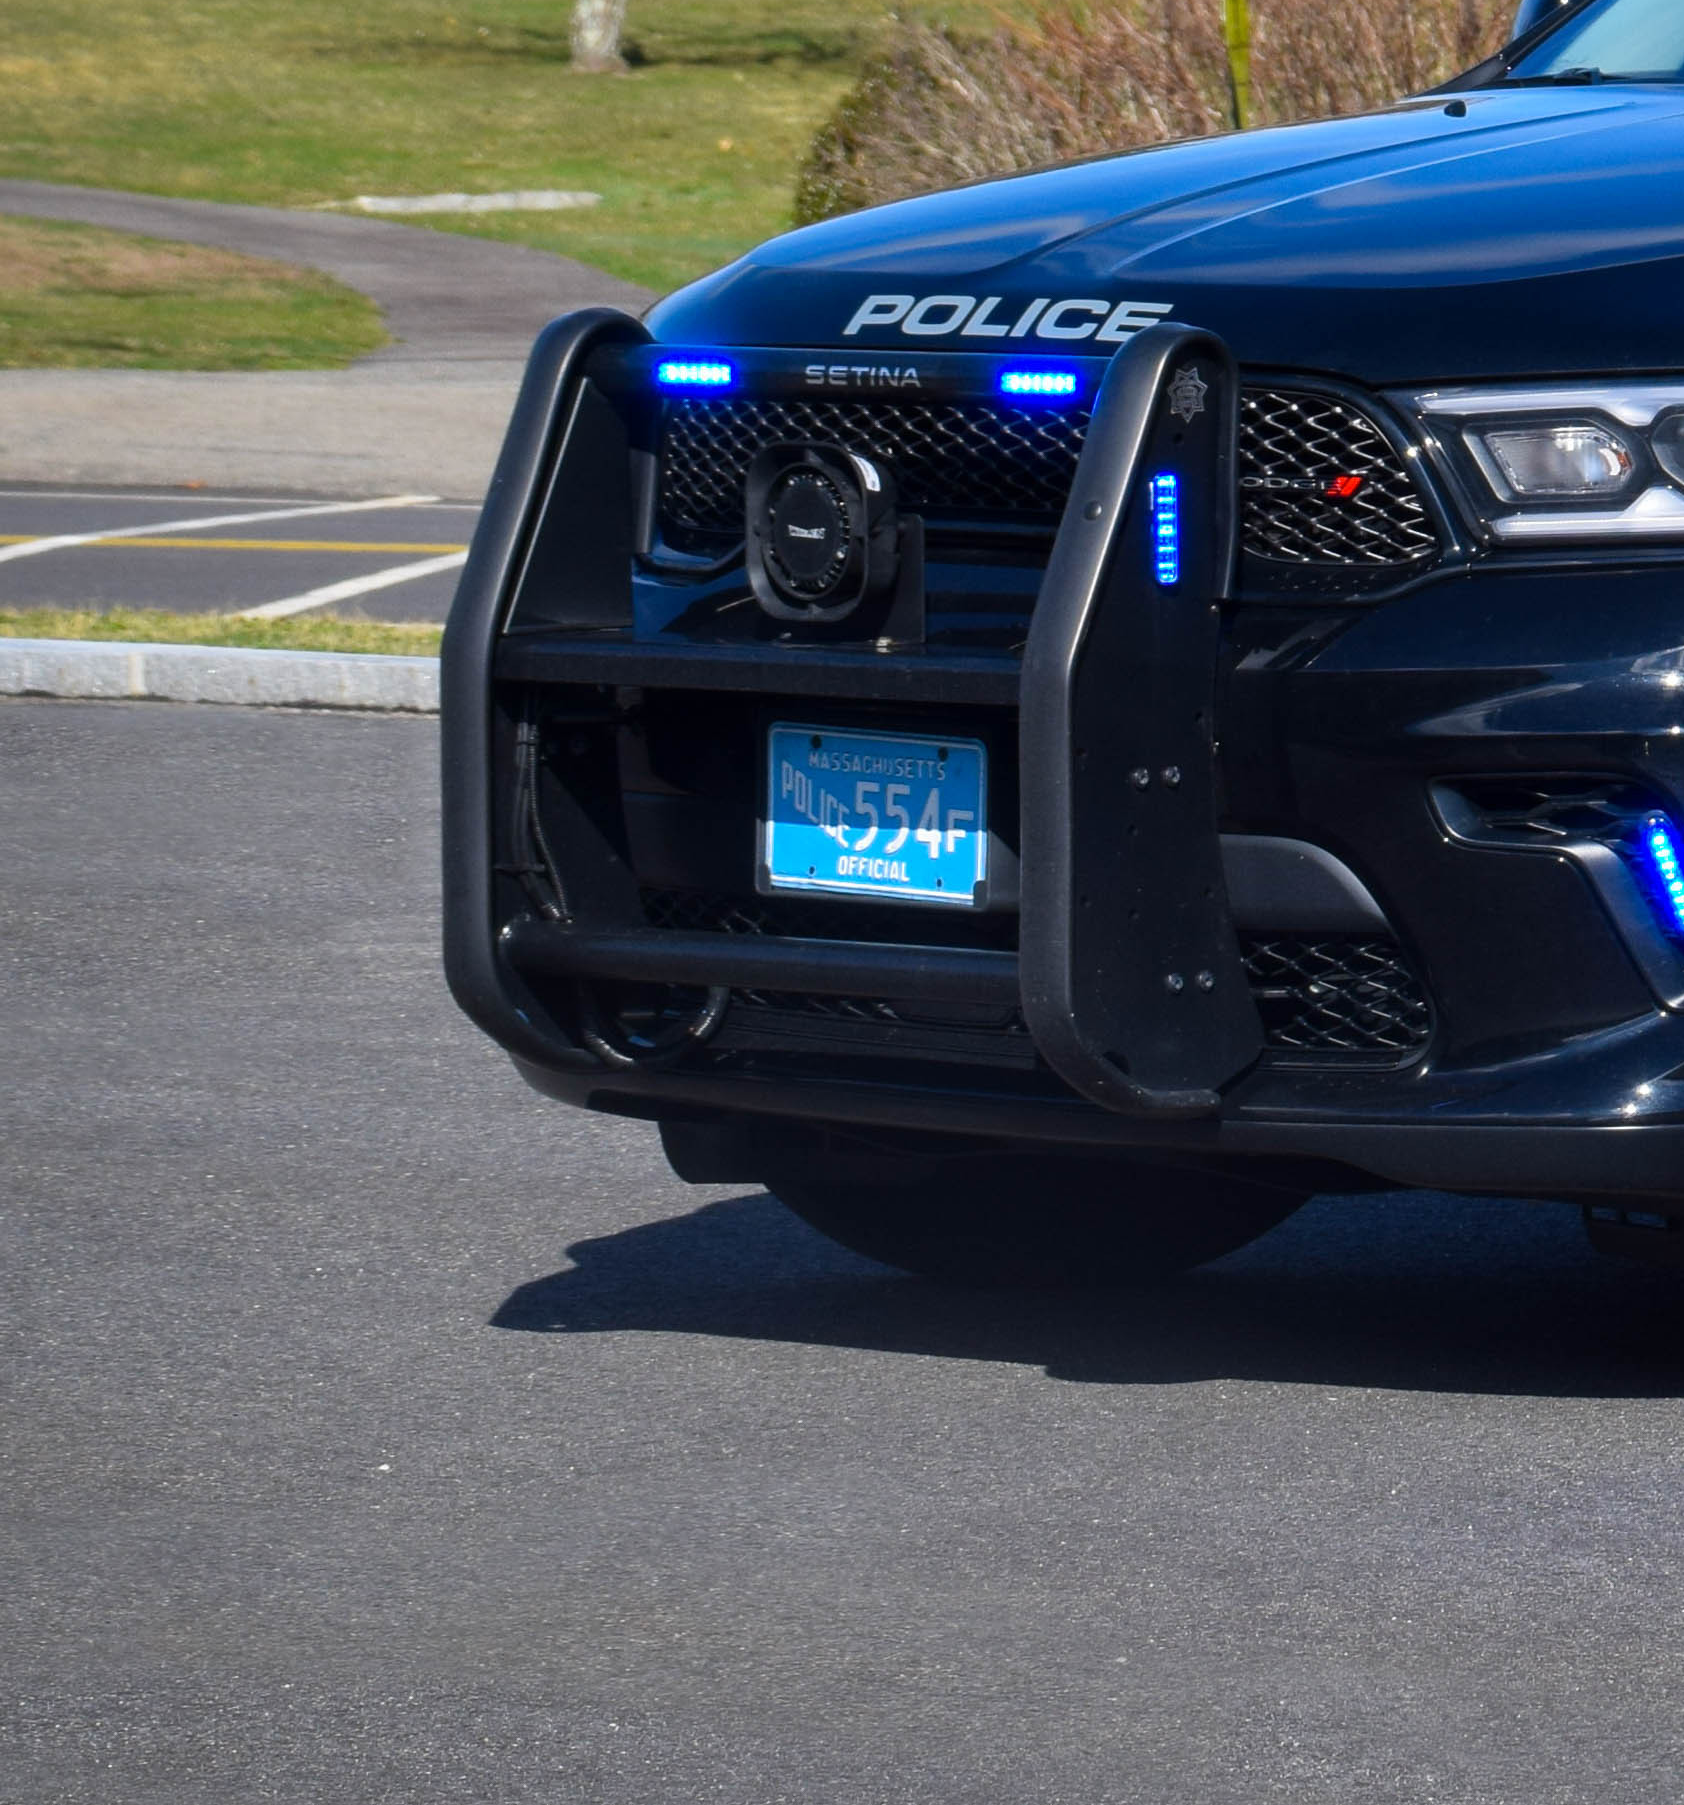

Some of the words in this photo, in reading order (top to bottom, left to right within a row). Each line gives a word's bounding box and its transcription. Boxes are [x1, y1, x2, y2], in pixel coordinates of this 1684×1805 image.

[843, 294, 1174, 342] POLICE
[805, 364, 922, 388] SETINA
[808, 751, 947, 781] MASSACHUSETTS
[781, 759, 851, 849] POLICE
[854, 780, 975, 861] 554F
[837, 856, 910, 883] OFFICIAL
